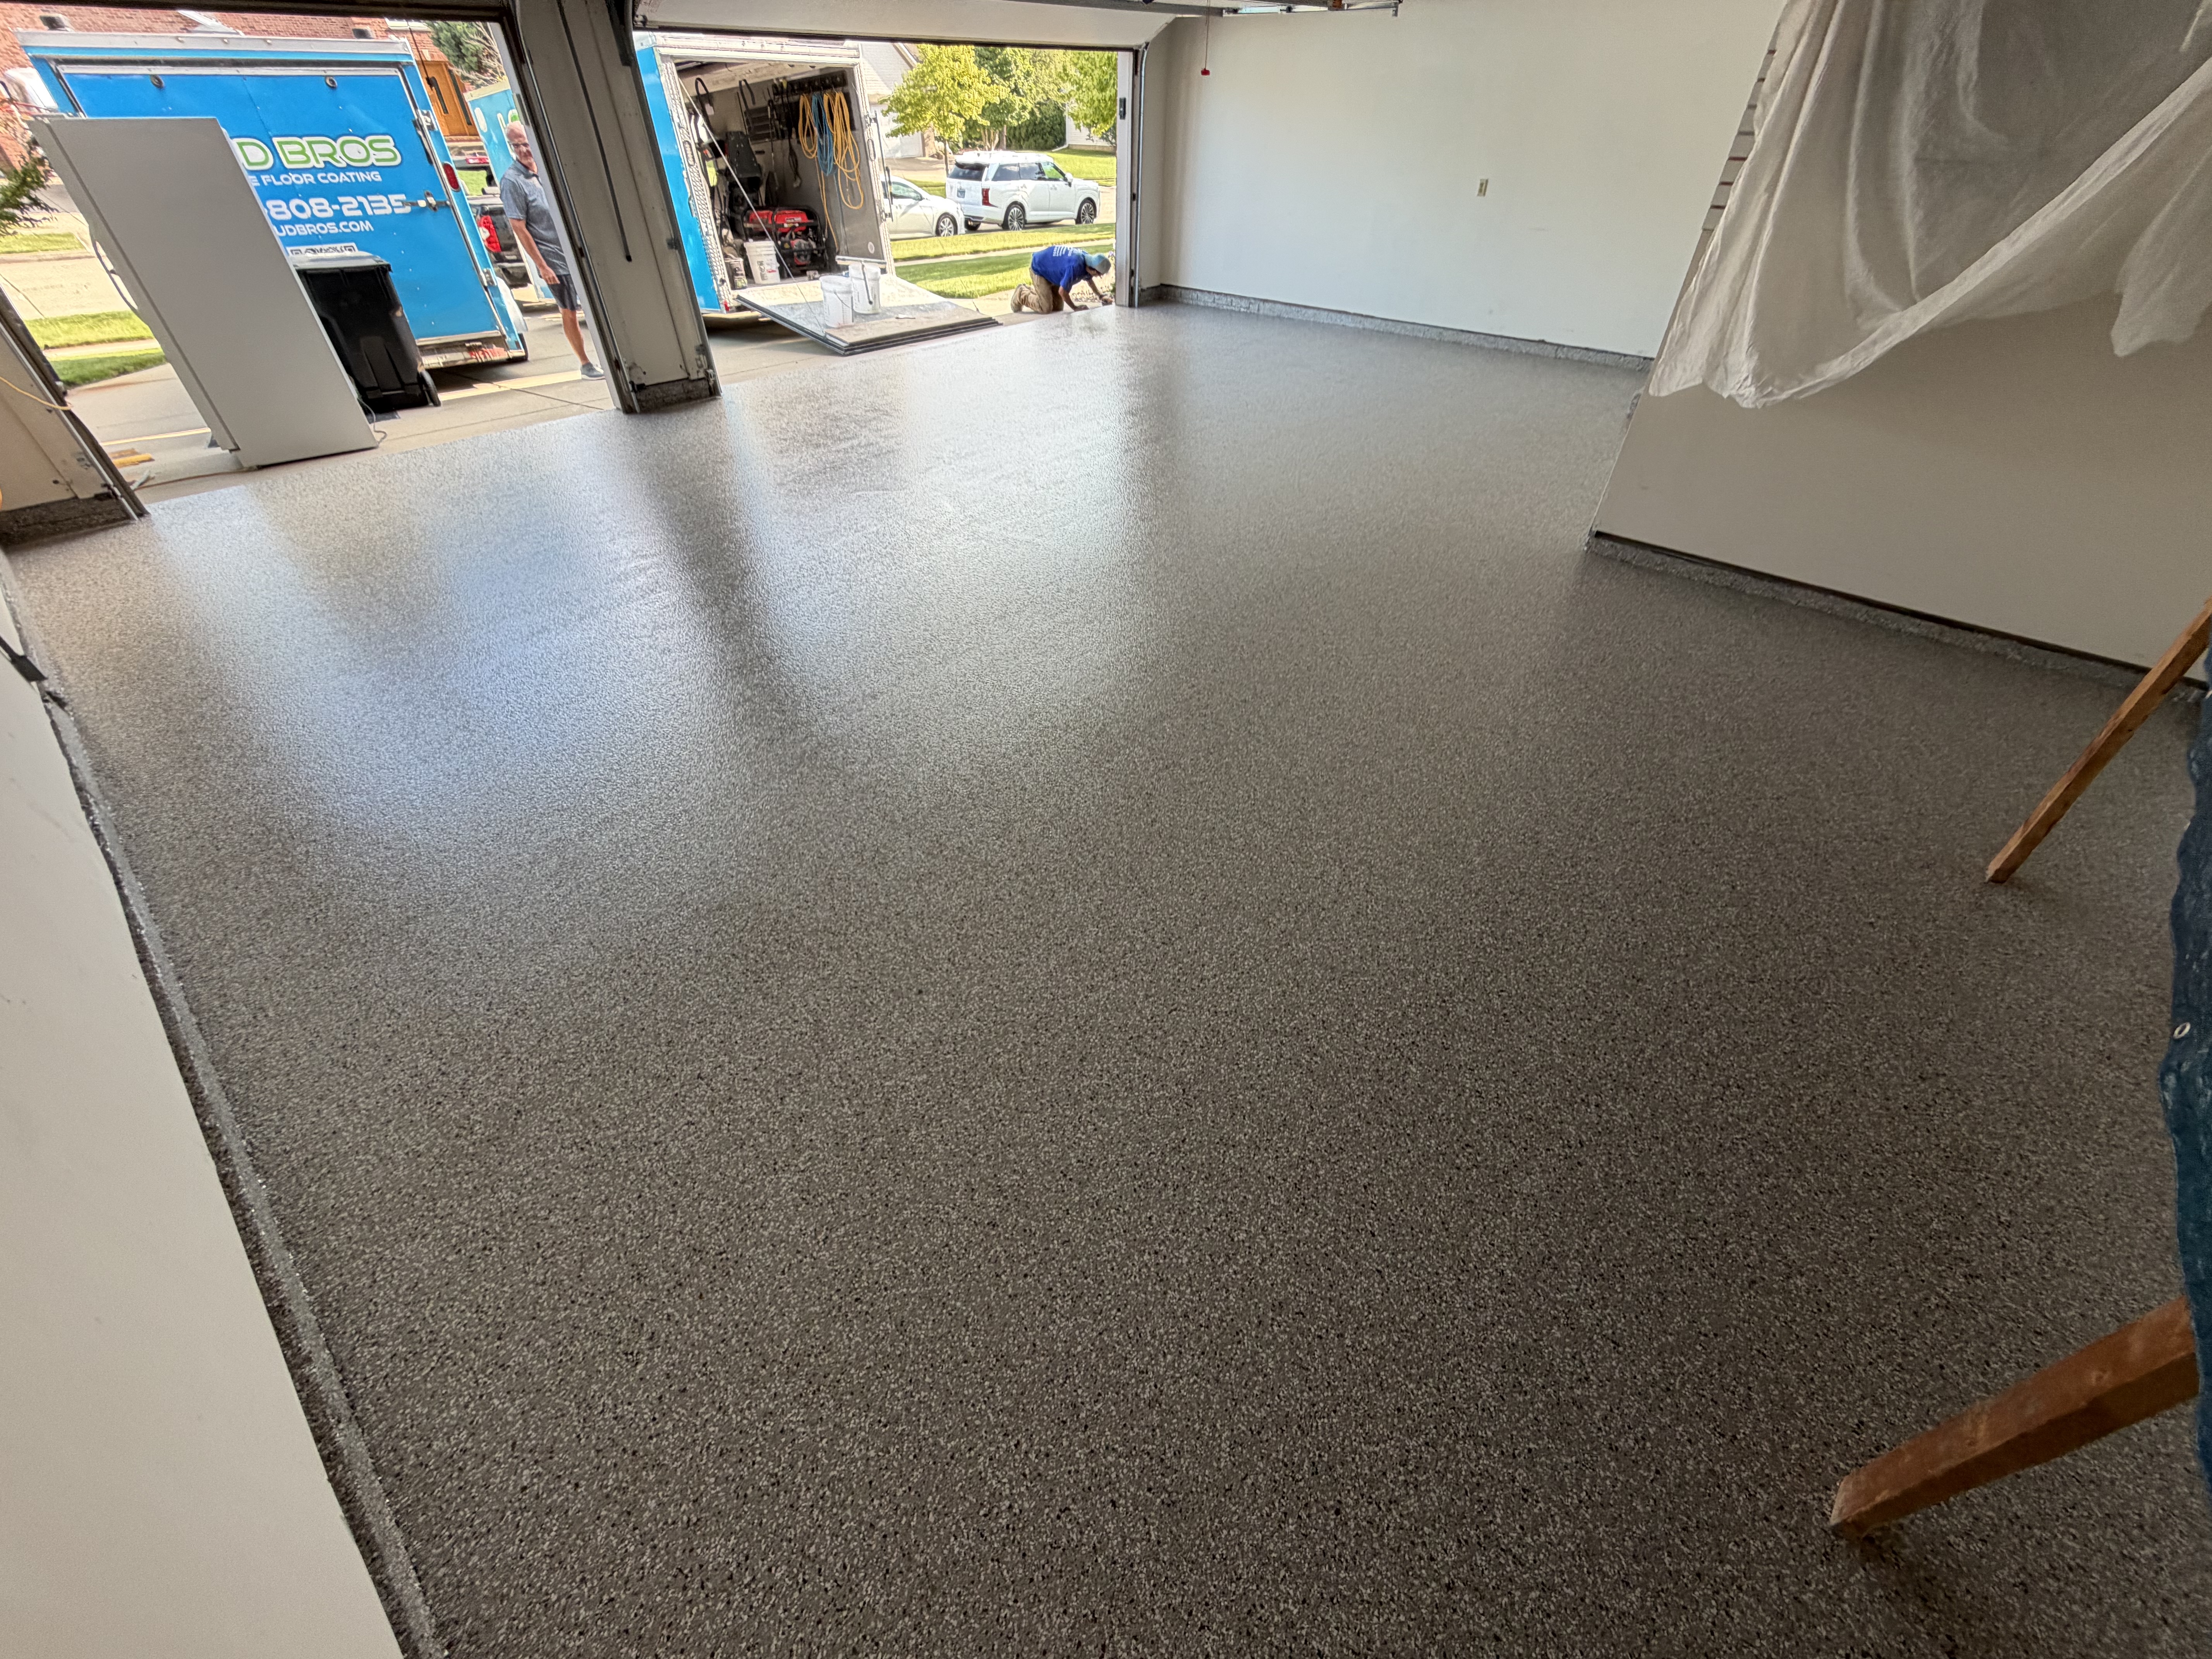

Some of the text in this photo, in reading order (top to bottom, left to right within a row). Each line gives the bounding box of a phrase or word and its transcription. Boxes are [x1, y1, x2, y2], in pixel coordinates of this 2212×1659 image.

[273, 136, 402, 168] BROS
[261, 173, 316, 186] FLOOR
[317, 171, 382, 184] COATING
[273, 220, 374, 237] UDBROS.COM
